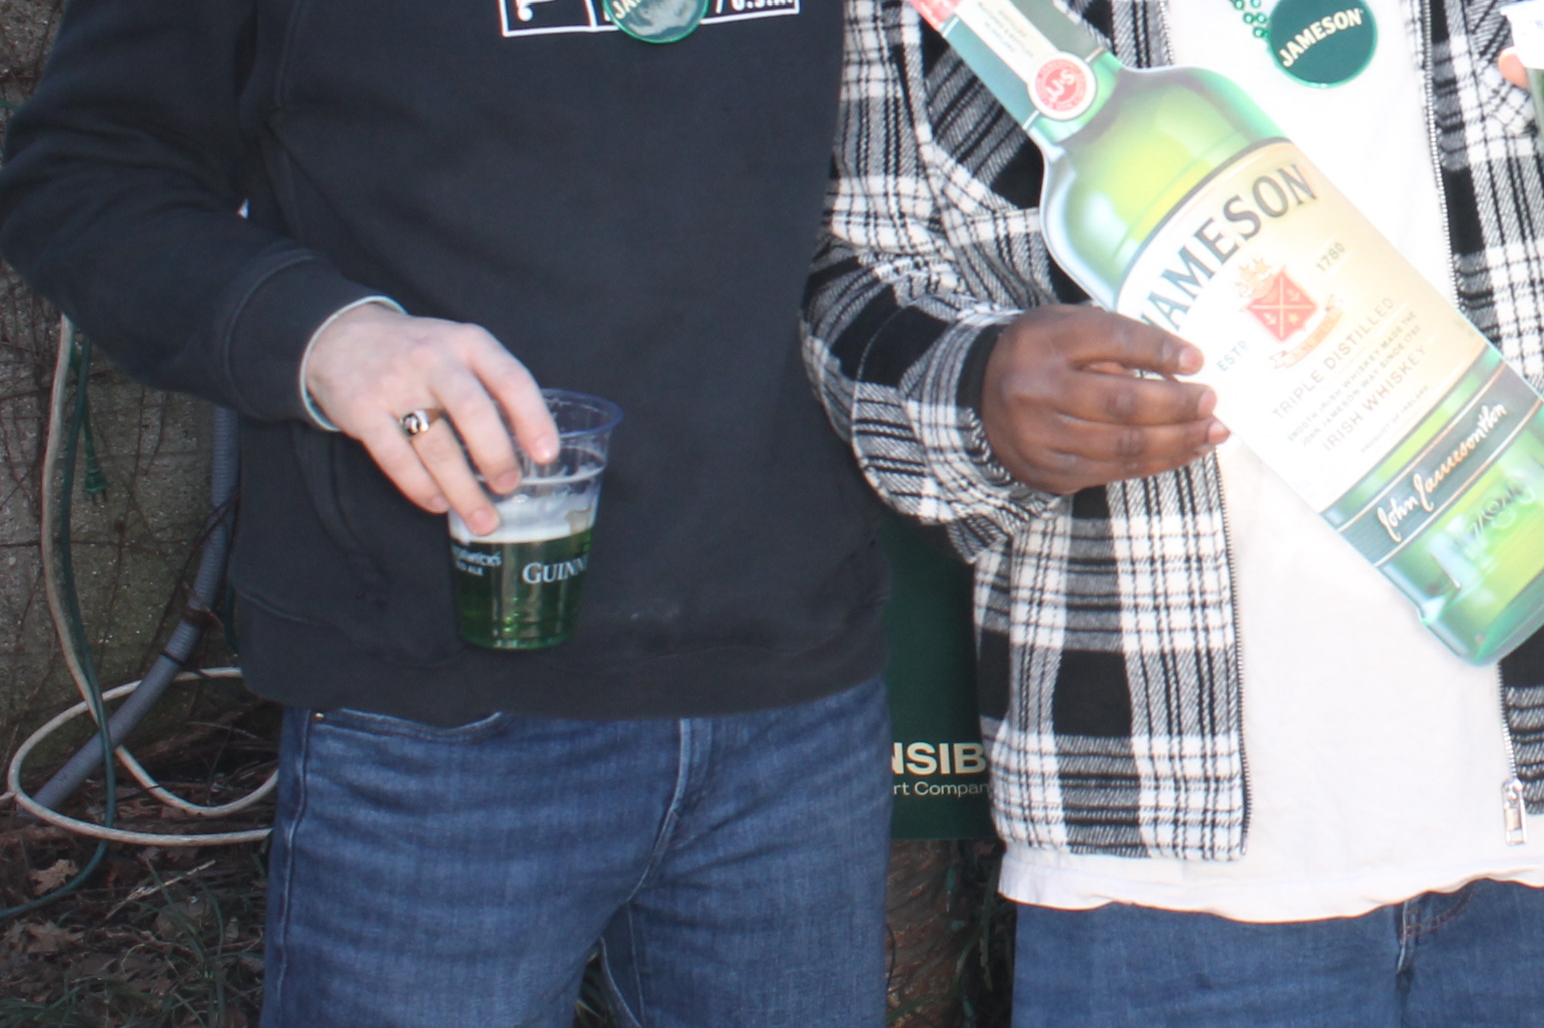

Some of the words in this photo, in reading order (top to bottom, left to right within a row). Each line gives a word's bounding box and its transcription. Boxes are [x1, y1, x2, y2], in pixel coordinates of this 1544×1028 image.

[1279, 8, 1363, 68] JAMESON
[1315, 241, 1346, 272] 1780
[1271, 369, 1325, 420] TRIPLE
[1323, 296, 1394, 371] DISTILLED
[1322, 411, 1364, 452] IRISH
[1361, 344, 1427, 412] WHISKEY
[1376, 495, 1420, 543] John
[521, 552, 590, 584] GUINN
[914, 780, 991, 798] Compan
